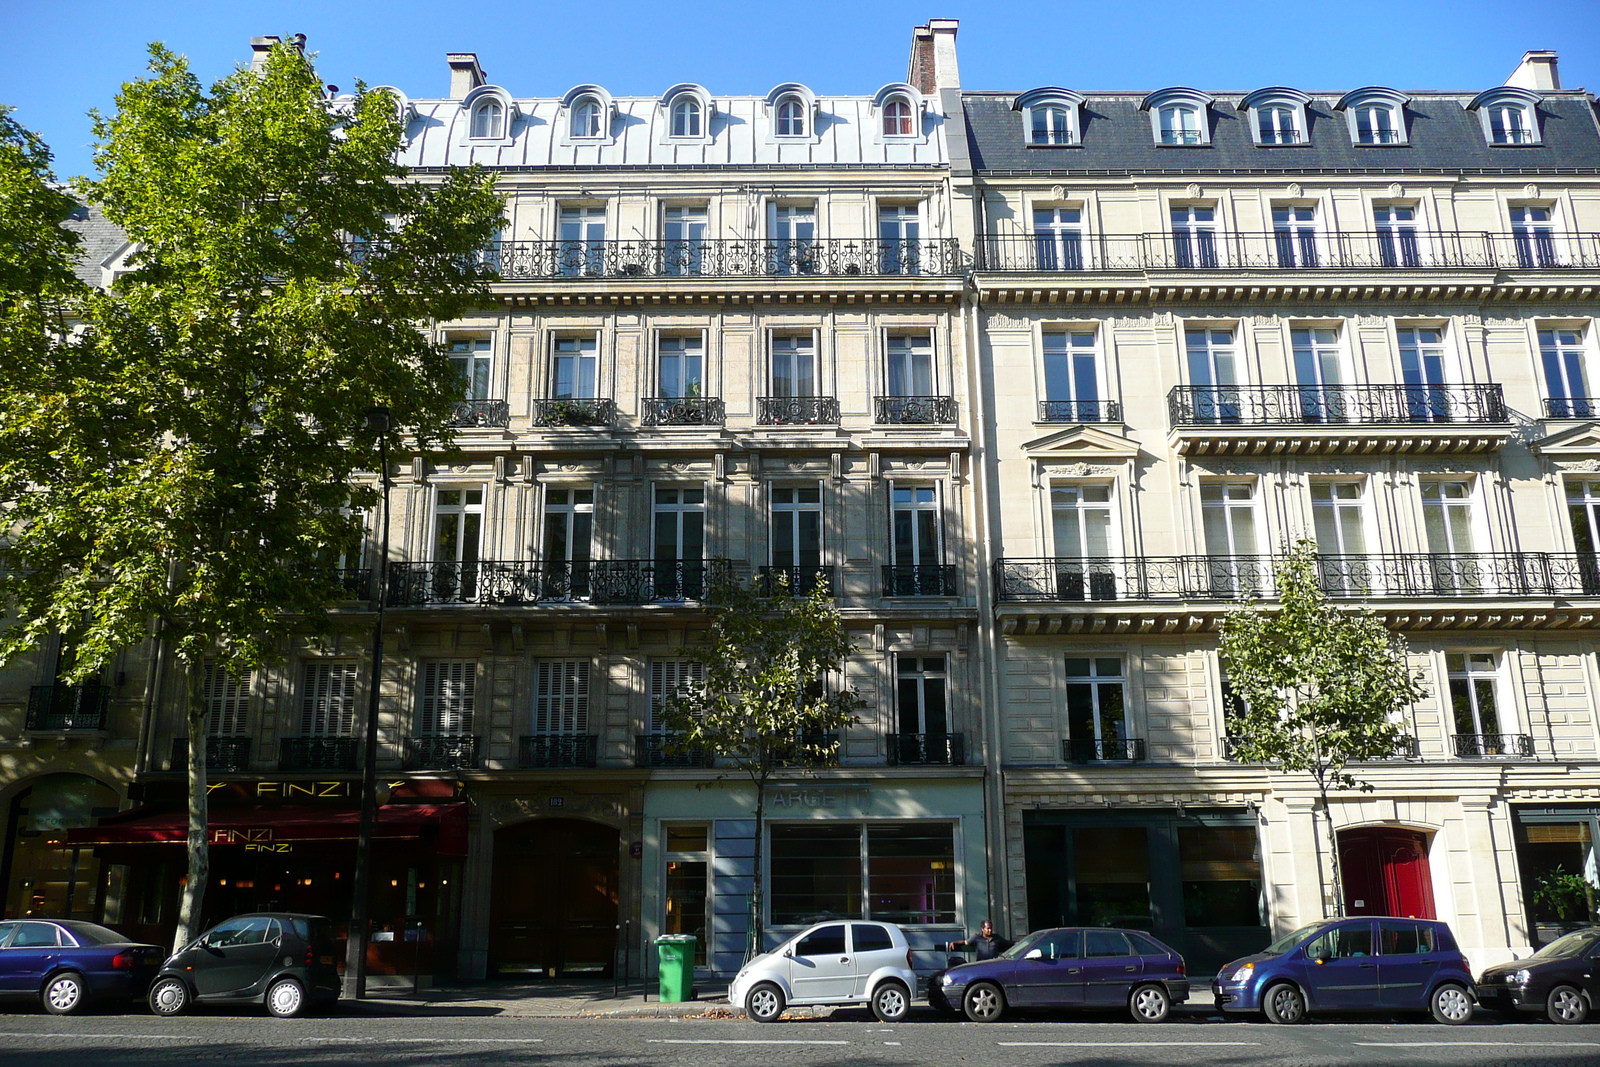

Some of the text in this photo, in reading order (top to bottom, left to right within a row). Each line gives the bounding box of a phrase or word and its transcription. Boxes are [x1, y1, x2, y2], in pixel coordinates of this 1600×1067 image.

[257, 782, 350, 797] FINZI
[214, 829, 273, 842] FINZI
[245, 844, 293, 852] FINZI
